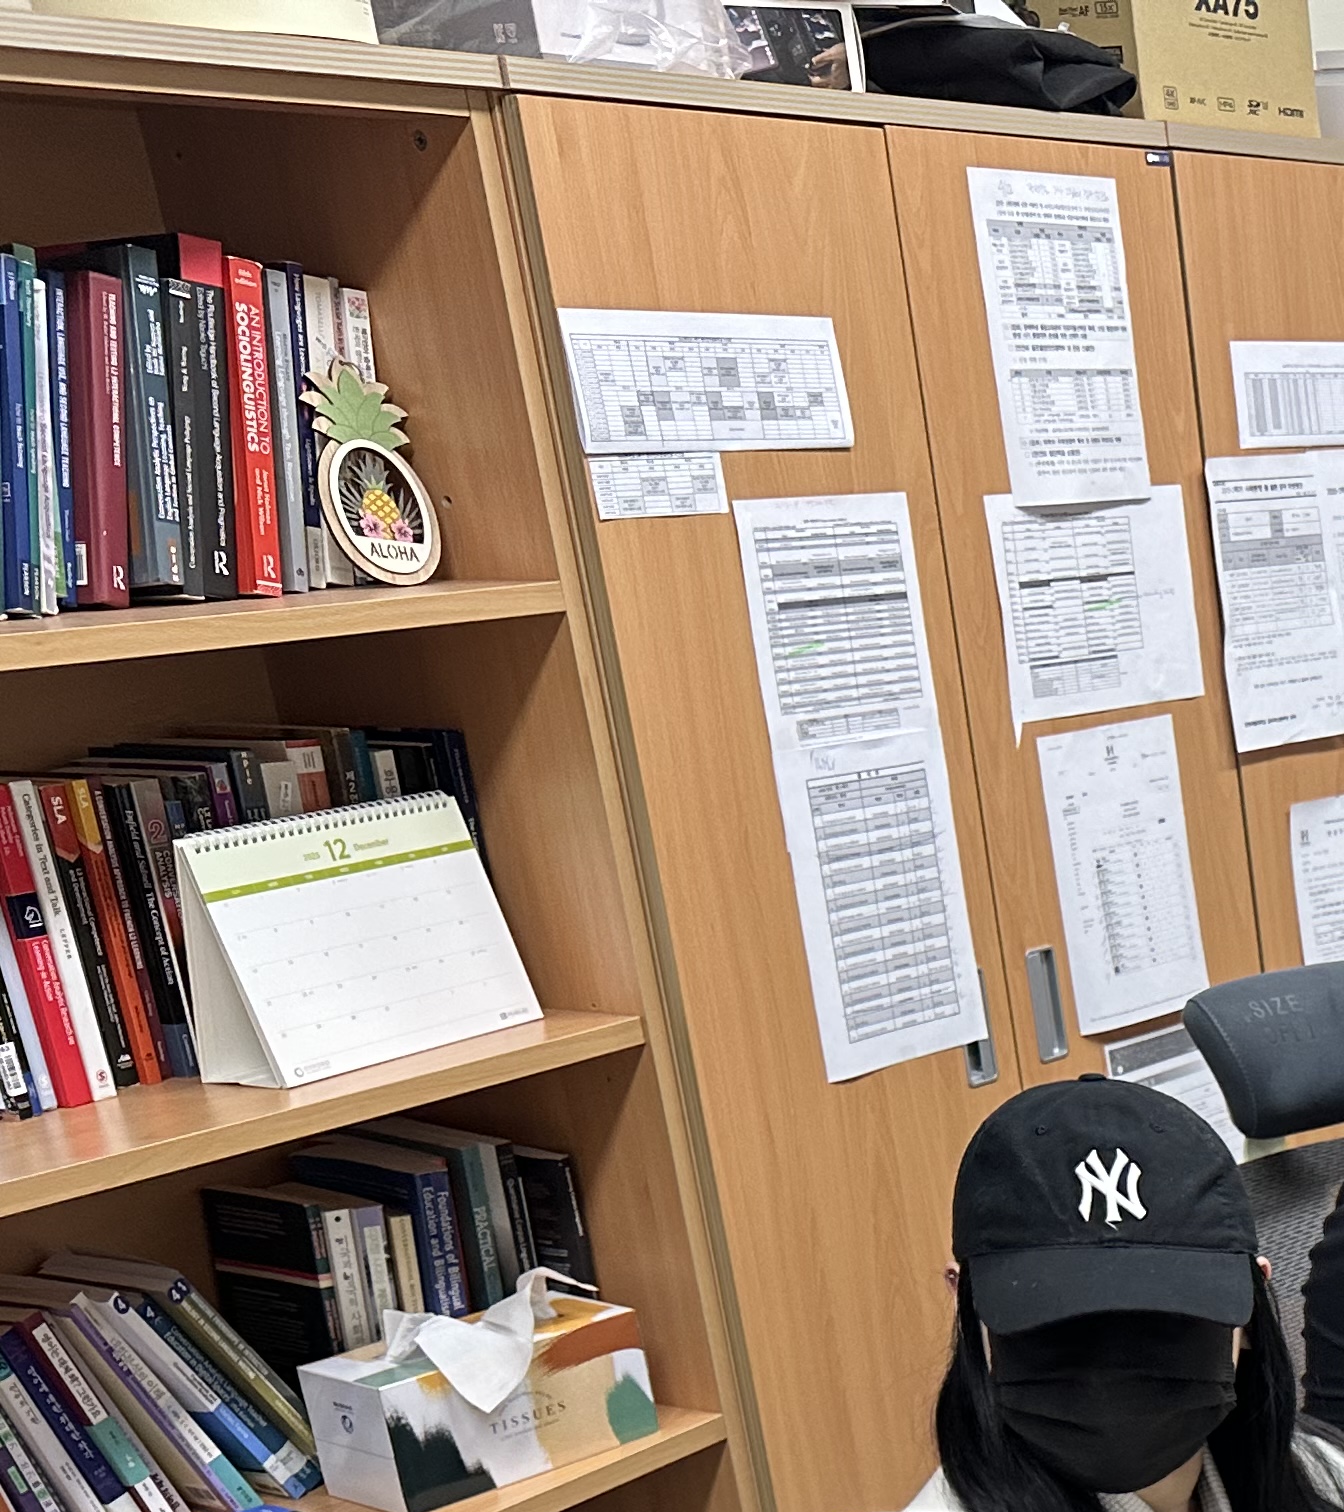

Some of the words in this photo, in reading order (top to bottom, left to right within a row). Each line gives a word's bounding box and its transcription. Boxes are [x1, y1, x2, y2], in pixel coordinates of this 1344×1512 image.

[248, 305, 260, 326] AN
[235, 301, 258, 451] SOCIOLINGUISTICS
[250, 330, 268, 431] INTRODUCTION
[259, 435, 270, 454] TO
[371, 541, 420, 563] ALOHA
[49, 796, 67, 824] SLA
[323, 838, 351, 860] 12
[144, 892, 157, 908] The
[148, 910, 165, 943] Concept
[420, 1187, 438, 1234] Education
[429, 1238, 442, 1256] and
[436, 1192, 456, 1249] Foundations
[445, 1253, 459, 1263] of
[489, 1400, 567, 1435] TISSUES
